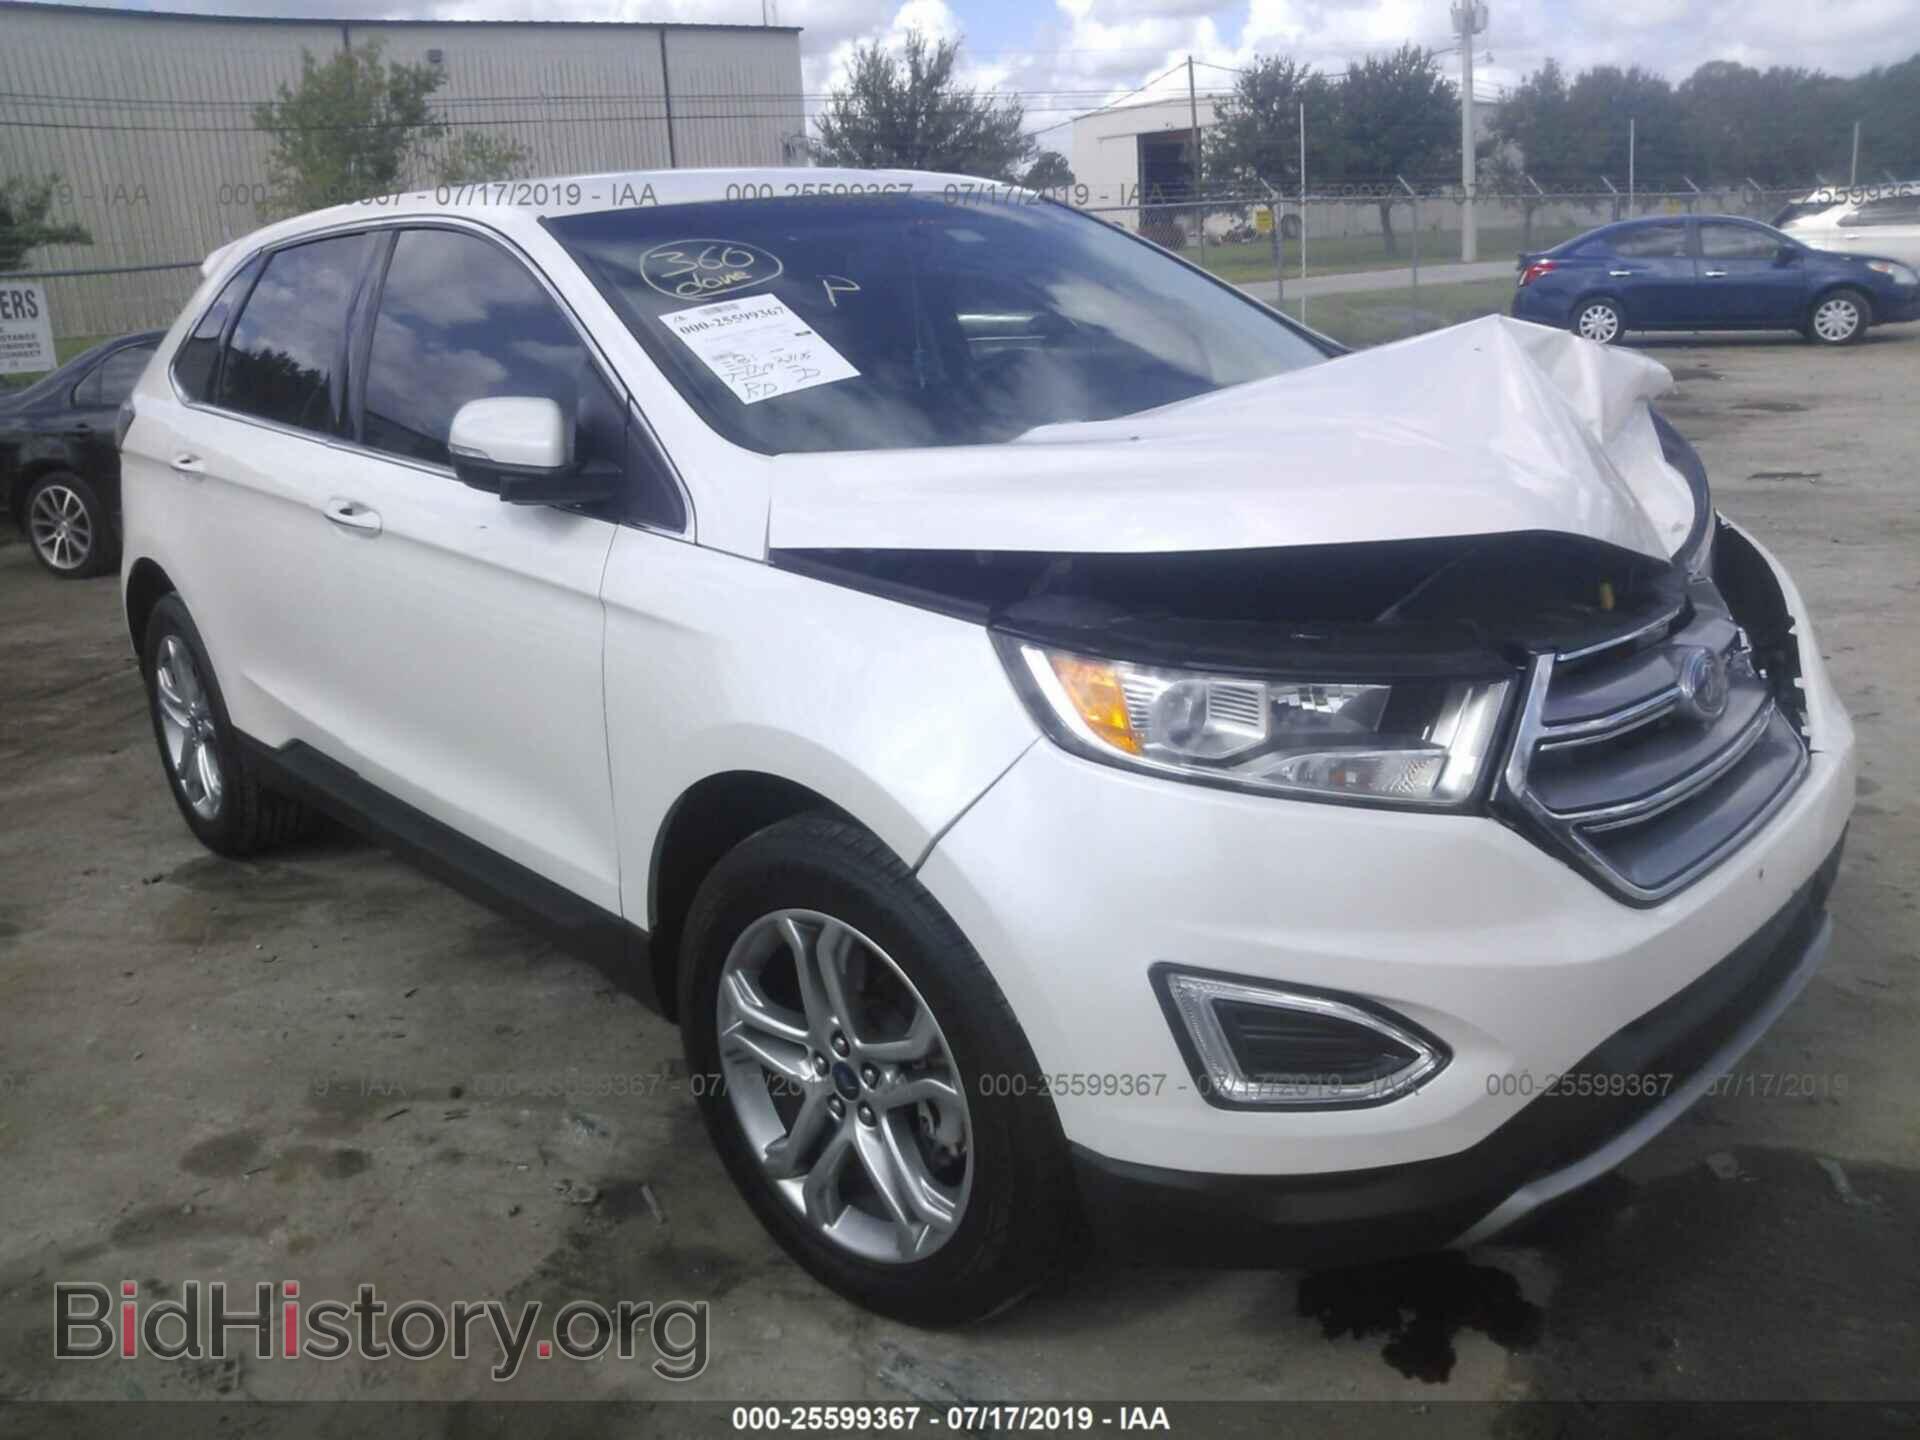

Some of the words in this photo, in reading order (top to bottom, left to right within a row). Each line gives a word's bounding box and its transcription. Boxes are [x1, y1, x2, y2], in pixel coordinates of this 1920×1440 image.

[650, 246, 755, 278] 360
[675, 269, 753, 296] done
[679, 305, 785, 336] 000-25599367
